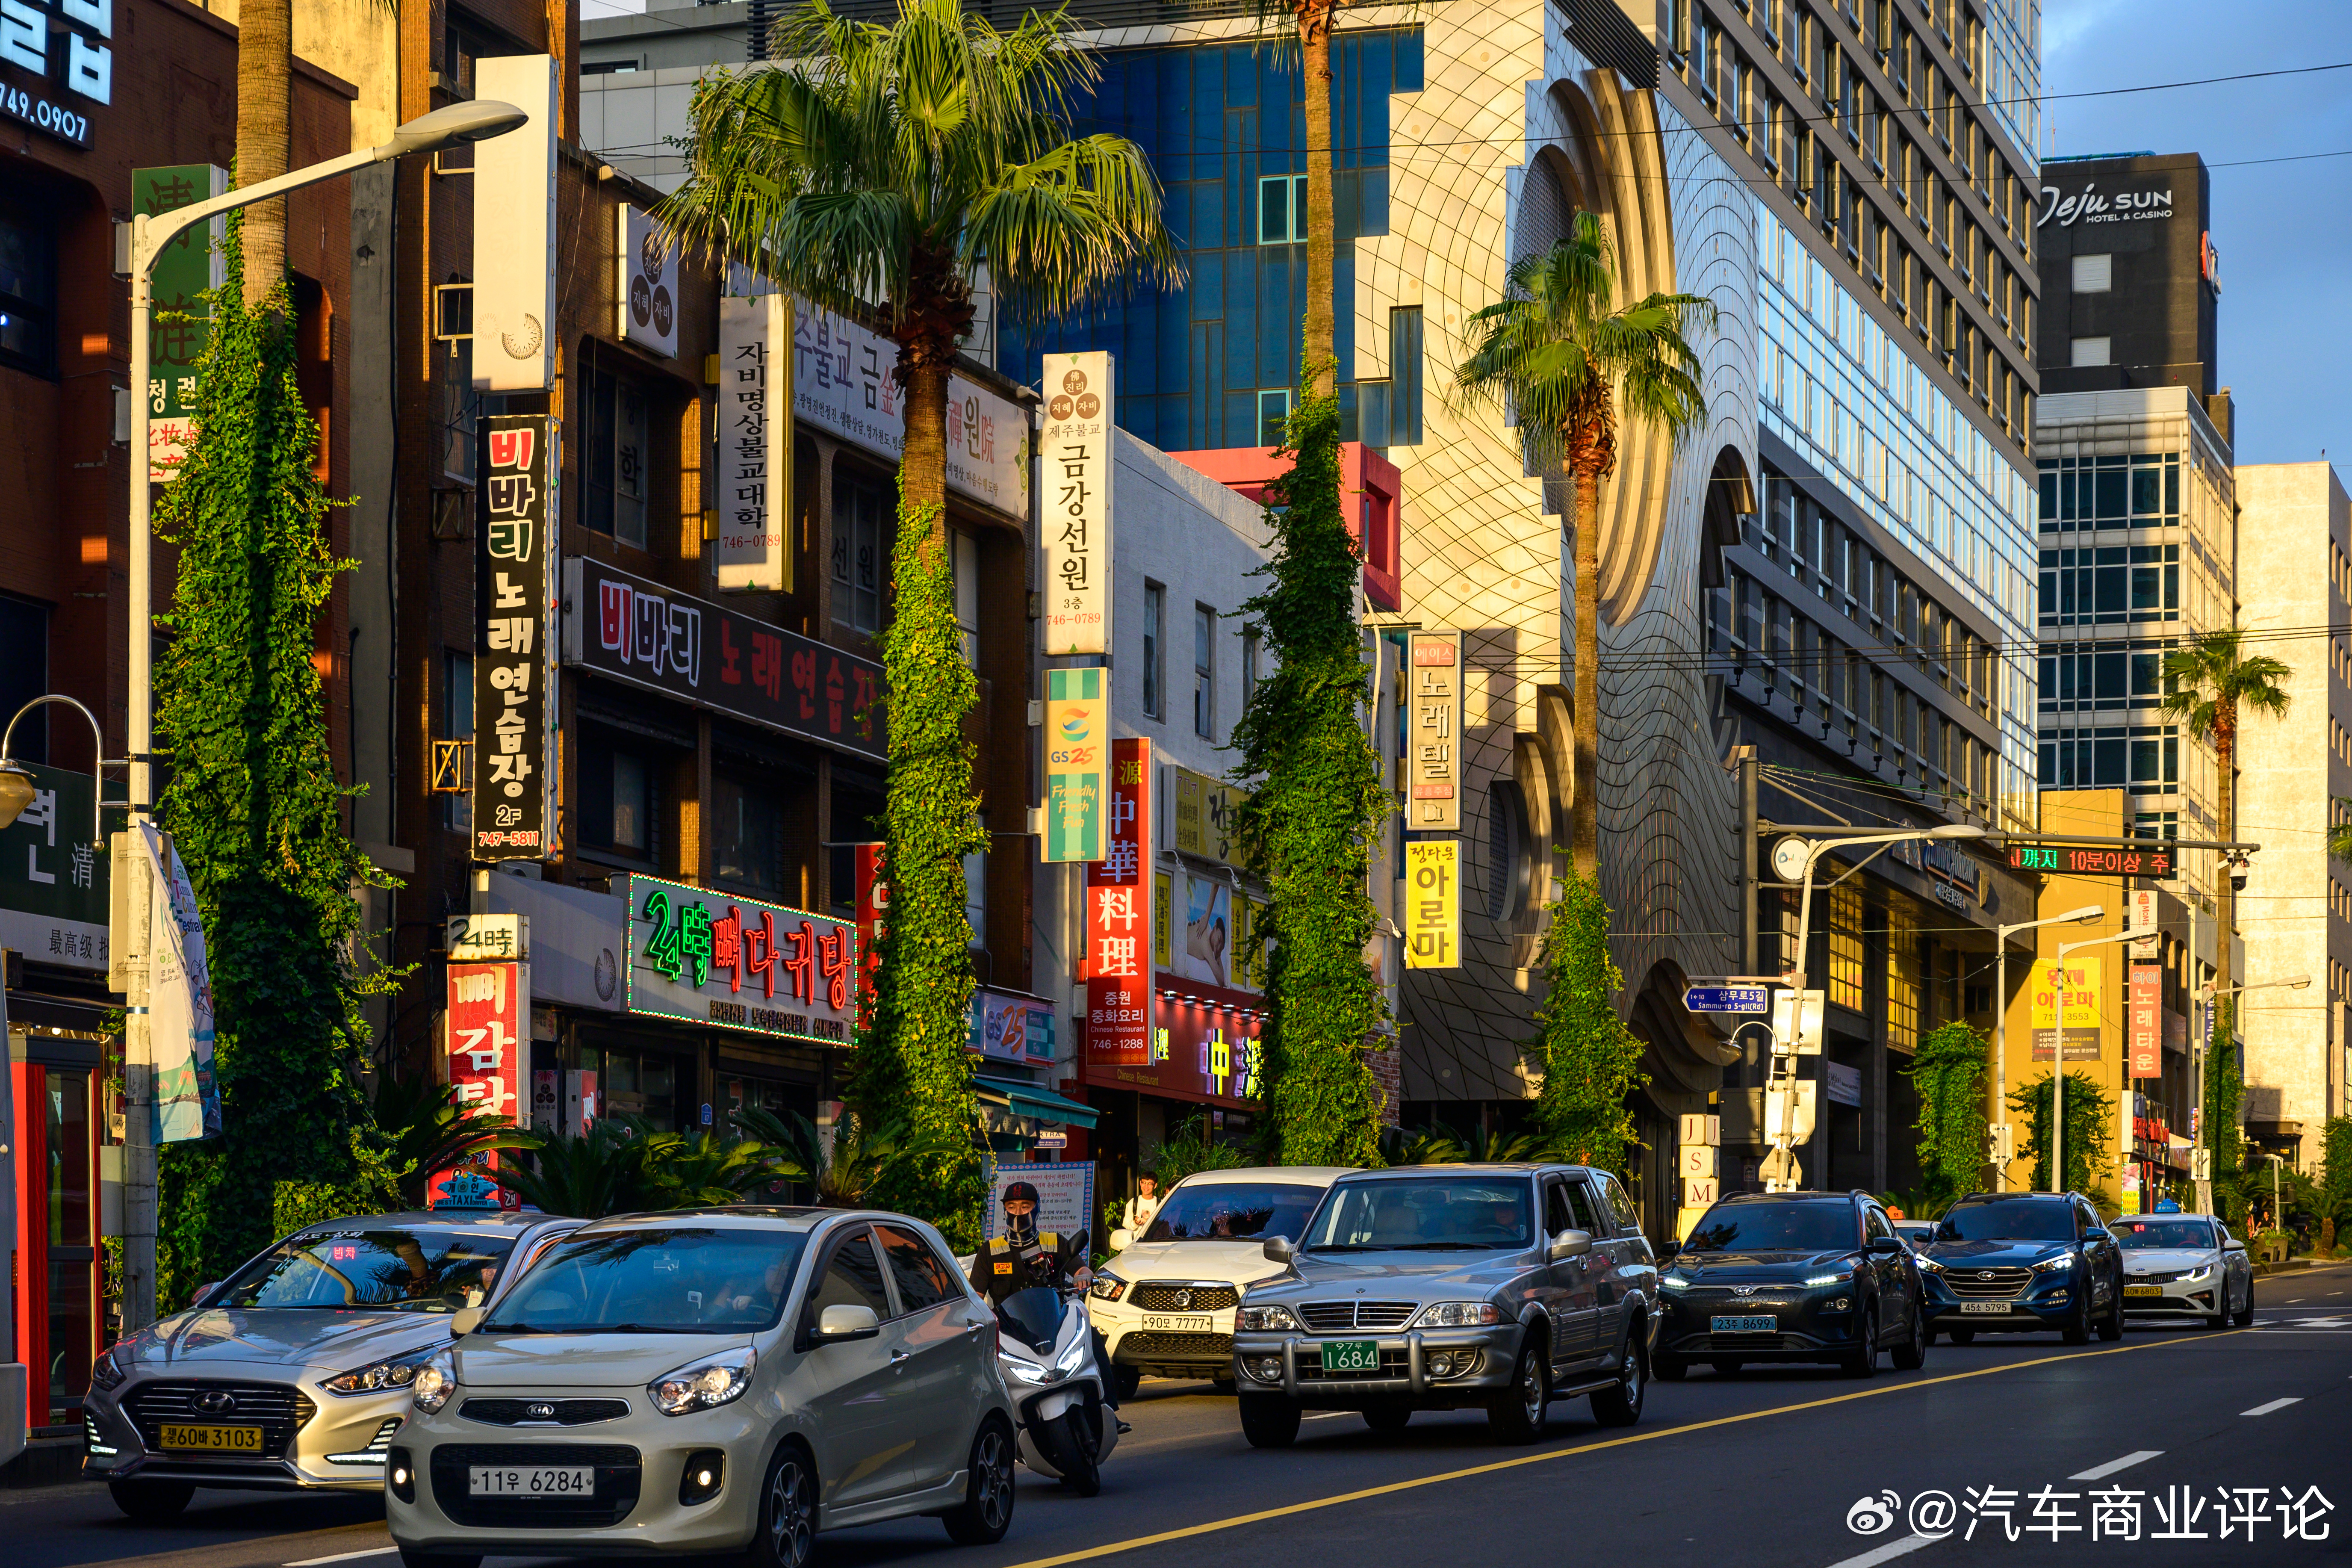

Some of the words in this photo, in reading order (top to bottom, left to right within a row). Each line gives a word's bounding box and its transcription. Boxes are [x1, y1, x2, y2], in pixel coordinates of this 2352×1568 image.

[0, 82, 86, 142] 749.0907
[2038, 183, 2109, 227] Jeju
[2116, 190, 2172, 210] SUN
[2087, 214, 2120, 223] HOTEL
[2134, 210, 2172, 220] CASINO
[633, 291, 649, 314] 지혜
[655, 301, 670, 324] 자비
[1065, 382, 1085, 393] 진리
[1052, 402, 1071, 413] 지혜
[1078, 400, 1097, 412] 자비
[734, 342, 770, 530] 자비명상불교대학
[1049, 423, 1101, 439] 제주불교
[946, 462, 998, 497] 비명상,마음수행도량
[489, 428, 536, 562] 비바리
[1058, 444, 1091, 592] 금강선원
[723, 534, 781, 549] 746-0789
[1064, 596, 1083, 610] 3층
[1046, 612, 1101, 626] 746-0789
[599, 579, 701, 687] 비바리
[721, 618, 878, 742] 노래연습장
[1415, 647, 1453, 664] 에이스
[487, 573, 534, 797] 노래연습장
[1417, 670, 1451, 779] 노래텔
[1051, 746, 1097, 765] GS25
[1112, 759, 1142, 785] 源
[1052, 784, 1096, 801] Friendly
[1414, 786, 1452, 797] 유흥주점
[496, 804, 522, 826] 2F
[1058, 799, 1089, 814] Fresh
[1422, 803, 1444, 821] B1
[1062, 815, 1085, 829] Fun
[478, 831, 539, 846] 747-5811
[1410, 846, 1454, 861] 정다운
[2069, 850, 2141, 873] 10분이상
[2150, 855, 2169, 874] 주
[1098, 791, 1139, 977] 中華料理
[1416, 865, 1449, 963] 아로마
[49, 928, 93, 960] 最高级
[450, 918, 513, 956] 24時
[643, 890, 711, 988] 24時
[710, 905, 852, 1010] 뼈다귀탕
[2133, 971, 2158, 985] 하이
[1105, 991, 1131, 1006] 중원
[1718, 990, 1764, 1002] 삼무로5길
[2037, 991, 2095, 1009] 아로마
[1734, 1002, 1764, 1011] 5-gil(Rd)
[1092, 1009, 1144, 1023] 중화요리
[986, 1005, 1026, 1054] GS25
[1115, 1025, 1145, 1033] Restaurant
[2136, 988, 2154, 1071] 노래타운
[1092, 1039, 1144, 1049] 746-1288
[1117, 1069, 1134, 1082] Chinese
[1136, 1072, 1159, 1086] Restaurant
[1690, 1152, 1702, 1171] S
[447, 1183, 455, 1193] 개
[471, 1183, 479, 1193] 인
[1691, 1184, 1712, 1202] M
[452, 1195, 473, 1205] TAXI
[334, 1247, 356, 1260] 빈차
[1965, 1303, 1982, 1313] 45소
[1985, 1302, 2007, 1312] 5795
[1148, 1317, 1170, 1329] 90모
[1175, 1317, 1205, 1330] 7777
[1717, 1319, 1738, 1330] 23주
[1743, 1318, 1771, 1329] 8699
[1336, 1342, 1363, 1351] 97루
[1328, 1351, 1376, 1369] 1684
[530, 1405, 550, 1415] KIA
[177, 1428, 209, 1445] 60바
[212, 1429, 256, 1447] 3103
[481, 1471, 520, 1492] 11우
[529, 1471, 584, 1492] 6284
